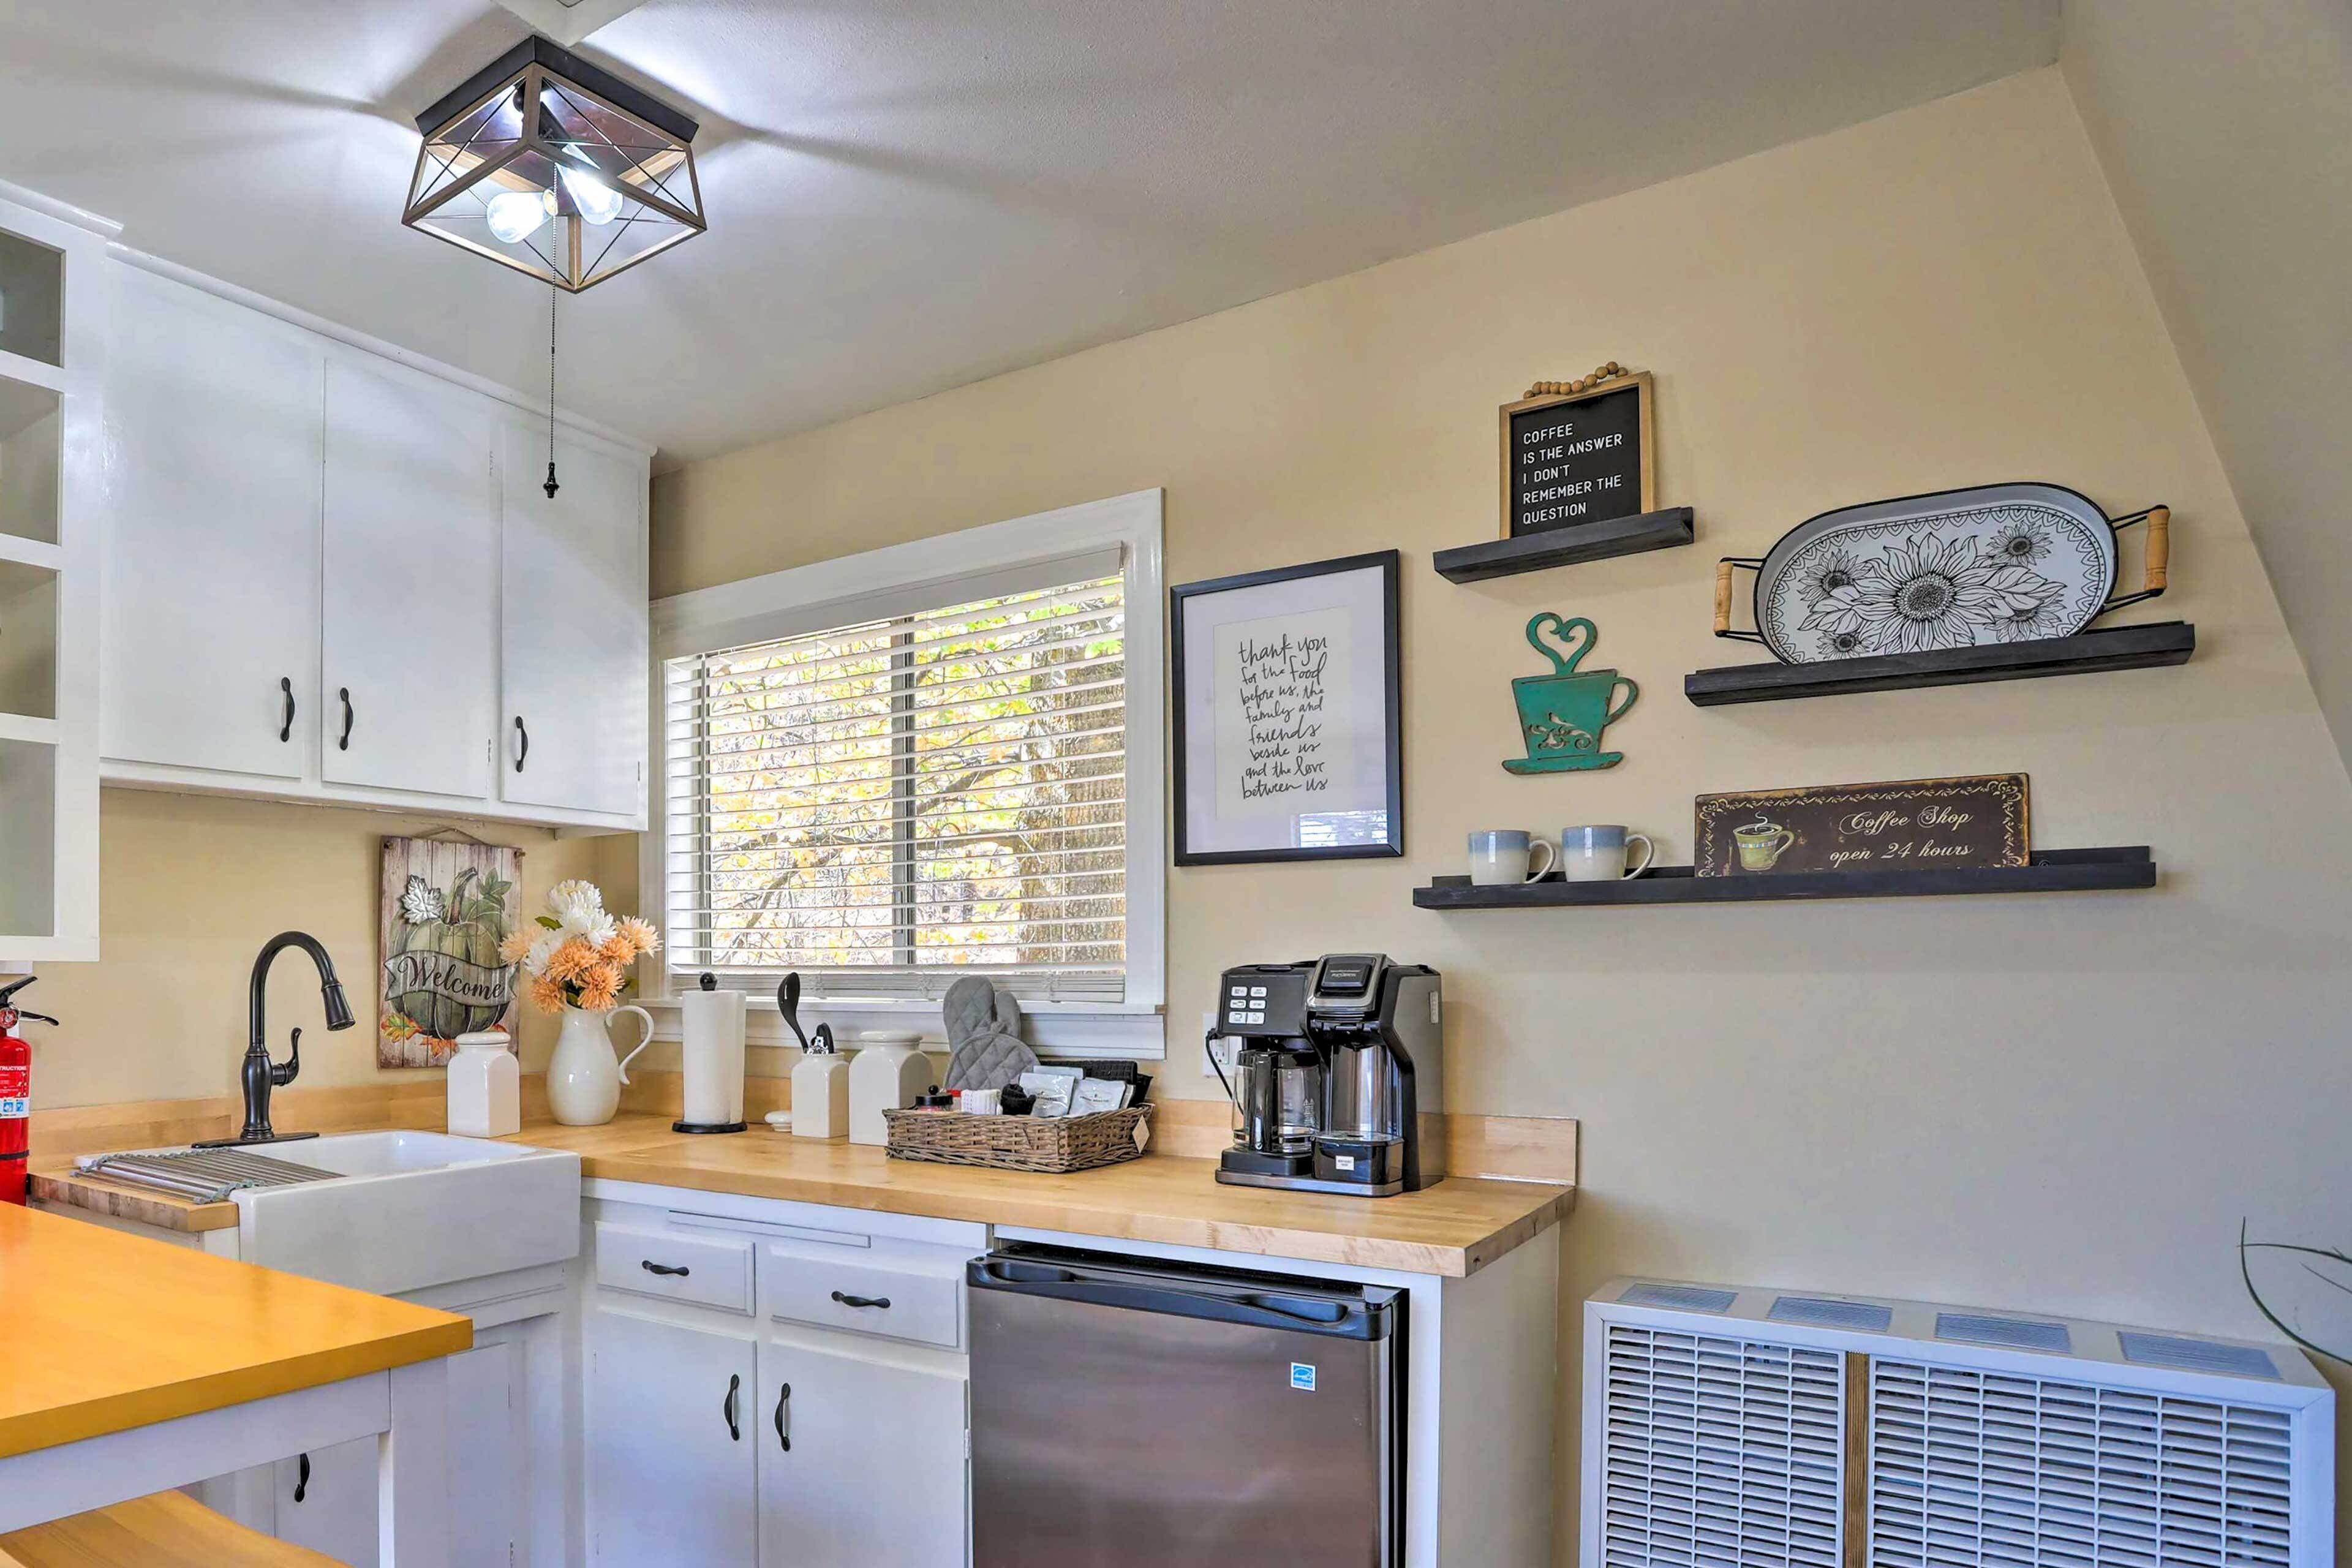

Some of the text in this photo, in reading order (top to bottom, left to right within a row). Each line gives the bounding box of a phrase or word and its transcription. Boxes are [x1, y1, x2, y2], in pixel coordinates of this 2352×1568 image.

[1523, 423, 1573, 444] COFFEE
[1523, 434, 1622, 464] IS THE ANSWER
[1523, 464, 1570, 484] I DON'T
[1523, 475, 1622, 505] REMEMBER THE
[1523, 502, 1586, 524] QUESTION
[1238, 633, 1327, 666] thank you
[1242, 666, 1256, 685] for
[1262, 663, 1285, 679] the
[1240, 685, 1274, 709] before
[1302, 680, 1324, 699] the
[1245, 696, 1323, 723] family and
[1248, 714, 1321, 745] friends
[1250, 742, 1321, 761] beside us
[1246, 756, 1325, 779] and the love
[1242, 775, 1328, 799] between us
[1839, 805, 1973, 836] Coffee Shop
[1830, 839, 1973, 869] open 24 hours
[398, 956, 505, 1000] Welcome
